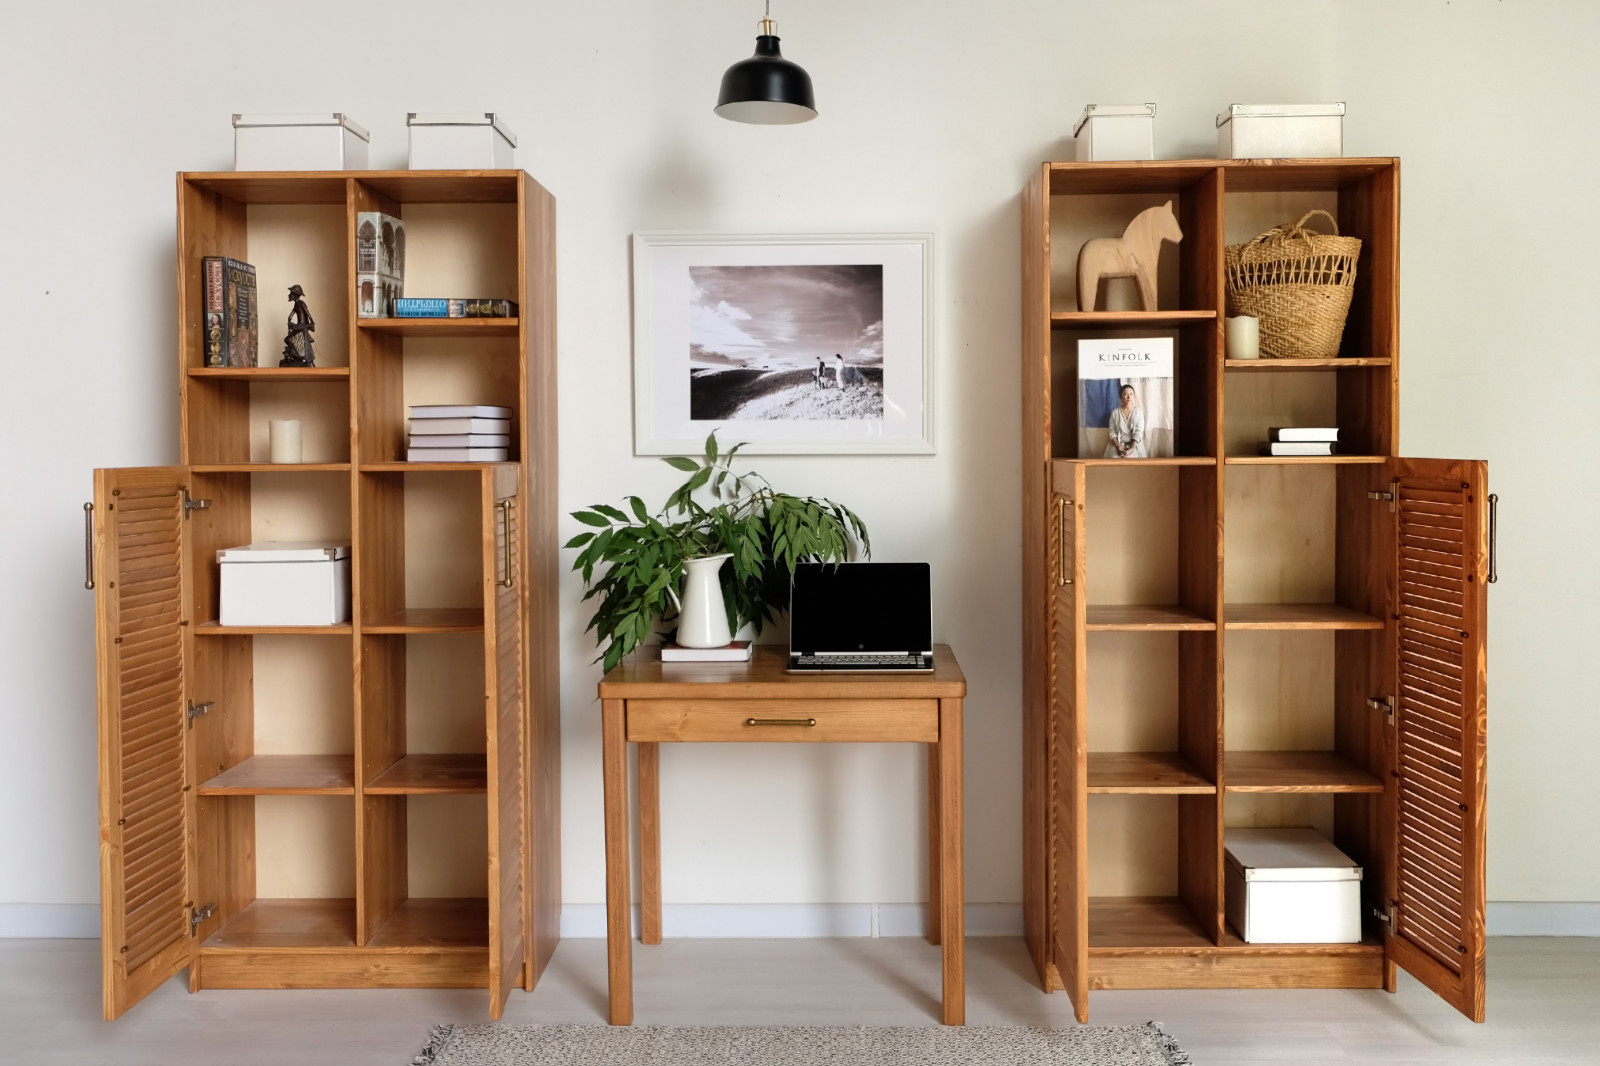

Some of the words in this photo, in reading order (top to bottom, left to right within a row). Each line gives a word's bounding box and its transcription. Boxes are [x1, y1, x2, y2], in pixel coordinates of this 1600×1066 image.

[213, 261, 223, 310] ИСКУССТВ
[397, 299, 447, 308] ОТКРЫТИЙ
[1098, 352, 1151, 362] KINFOLK
